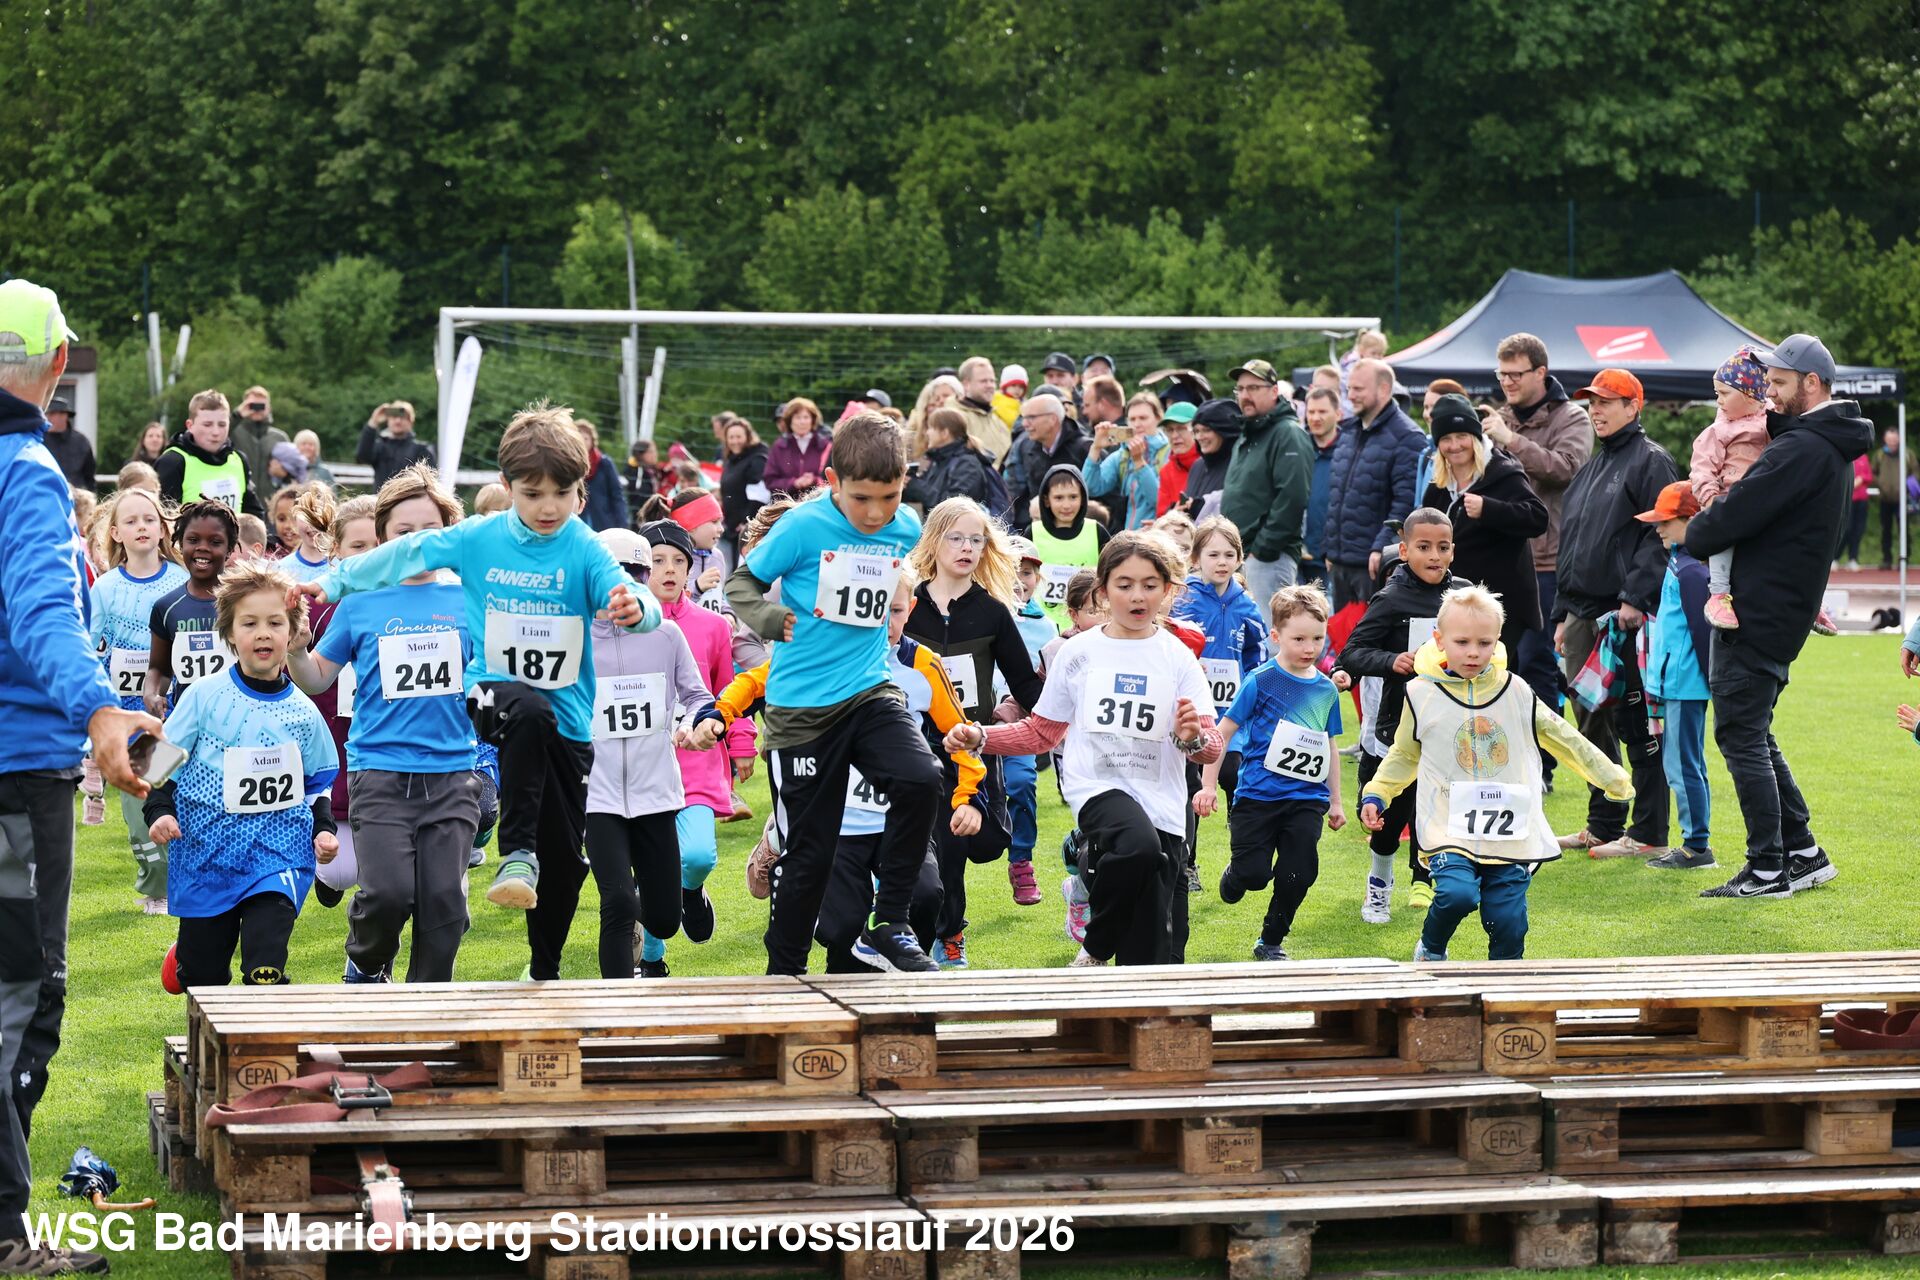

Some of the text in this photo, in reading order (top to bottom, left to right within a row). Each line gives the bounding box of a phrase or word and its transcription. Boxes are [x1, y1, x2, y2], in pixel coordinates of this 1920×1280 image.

[856, 565, 882, 576] Miika
[1046, 582, 1066, 599] 23
[509, 599, 561, 614] Schütz
[836, 586, 888, 620] 198
[522, 626, 550, 637] Liam
[408, 642, 439, 652] Moritz
[181, 655, 224, 678] 312
[503, 646, 566, 681] 187
[119, 671, 145, 691] 27
[396, 661, 451, 691] 244
[614, 683, 646, 691] Mathilda
[1208, 681, 1235, 702] 02
[603, 702, 651, 732] 151
[1097, 698, 1155, 732] 315
[1299, 734, 1322, 746] Jannes
[252, 757, 280, 765] Adam
[793, 757, 816, 776] MS
[1277, 747, 1324, 777] 223
[240, 774, 293, 806] 262
[1480, 791, 1502, 799] Emil
[1465, 810, 1514, 835] 172
[1503, 1035, 1538, 1052] EPAL
[802, 1056, 839, 1073] EPAL
[1490, 1130, 1526, 1149] EPAL
[836, 1152, 874, 1171] EPAL
